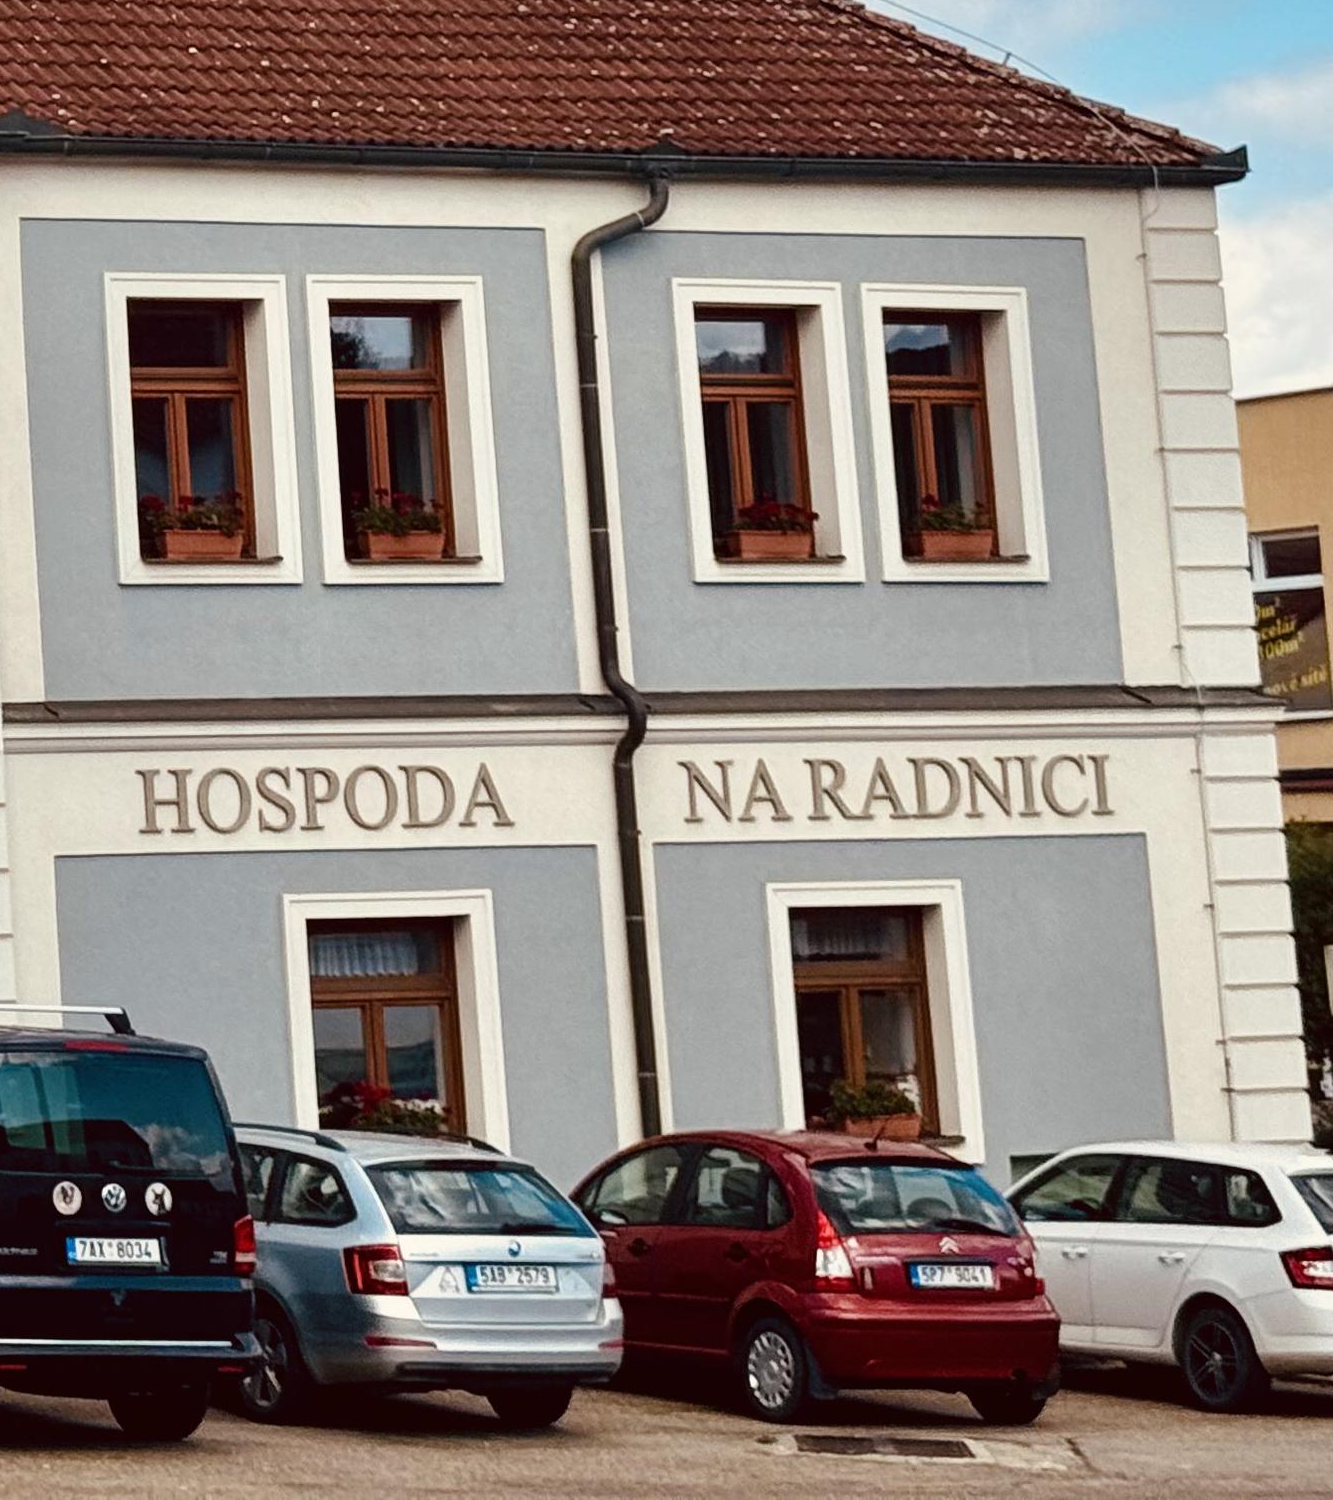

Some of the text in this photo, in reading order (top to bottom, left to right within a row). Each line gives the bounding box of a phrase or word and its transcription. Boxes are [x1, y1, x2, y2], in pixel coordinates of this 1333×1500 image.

[135, 754, 1115, 834] HOSPODA NA RADNICI
[79, 1240, 152, 1258] 7AX 8034
